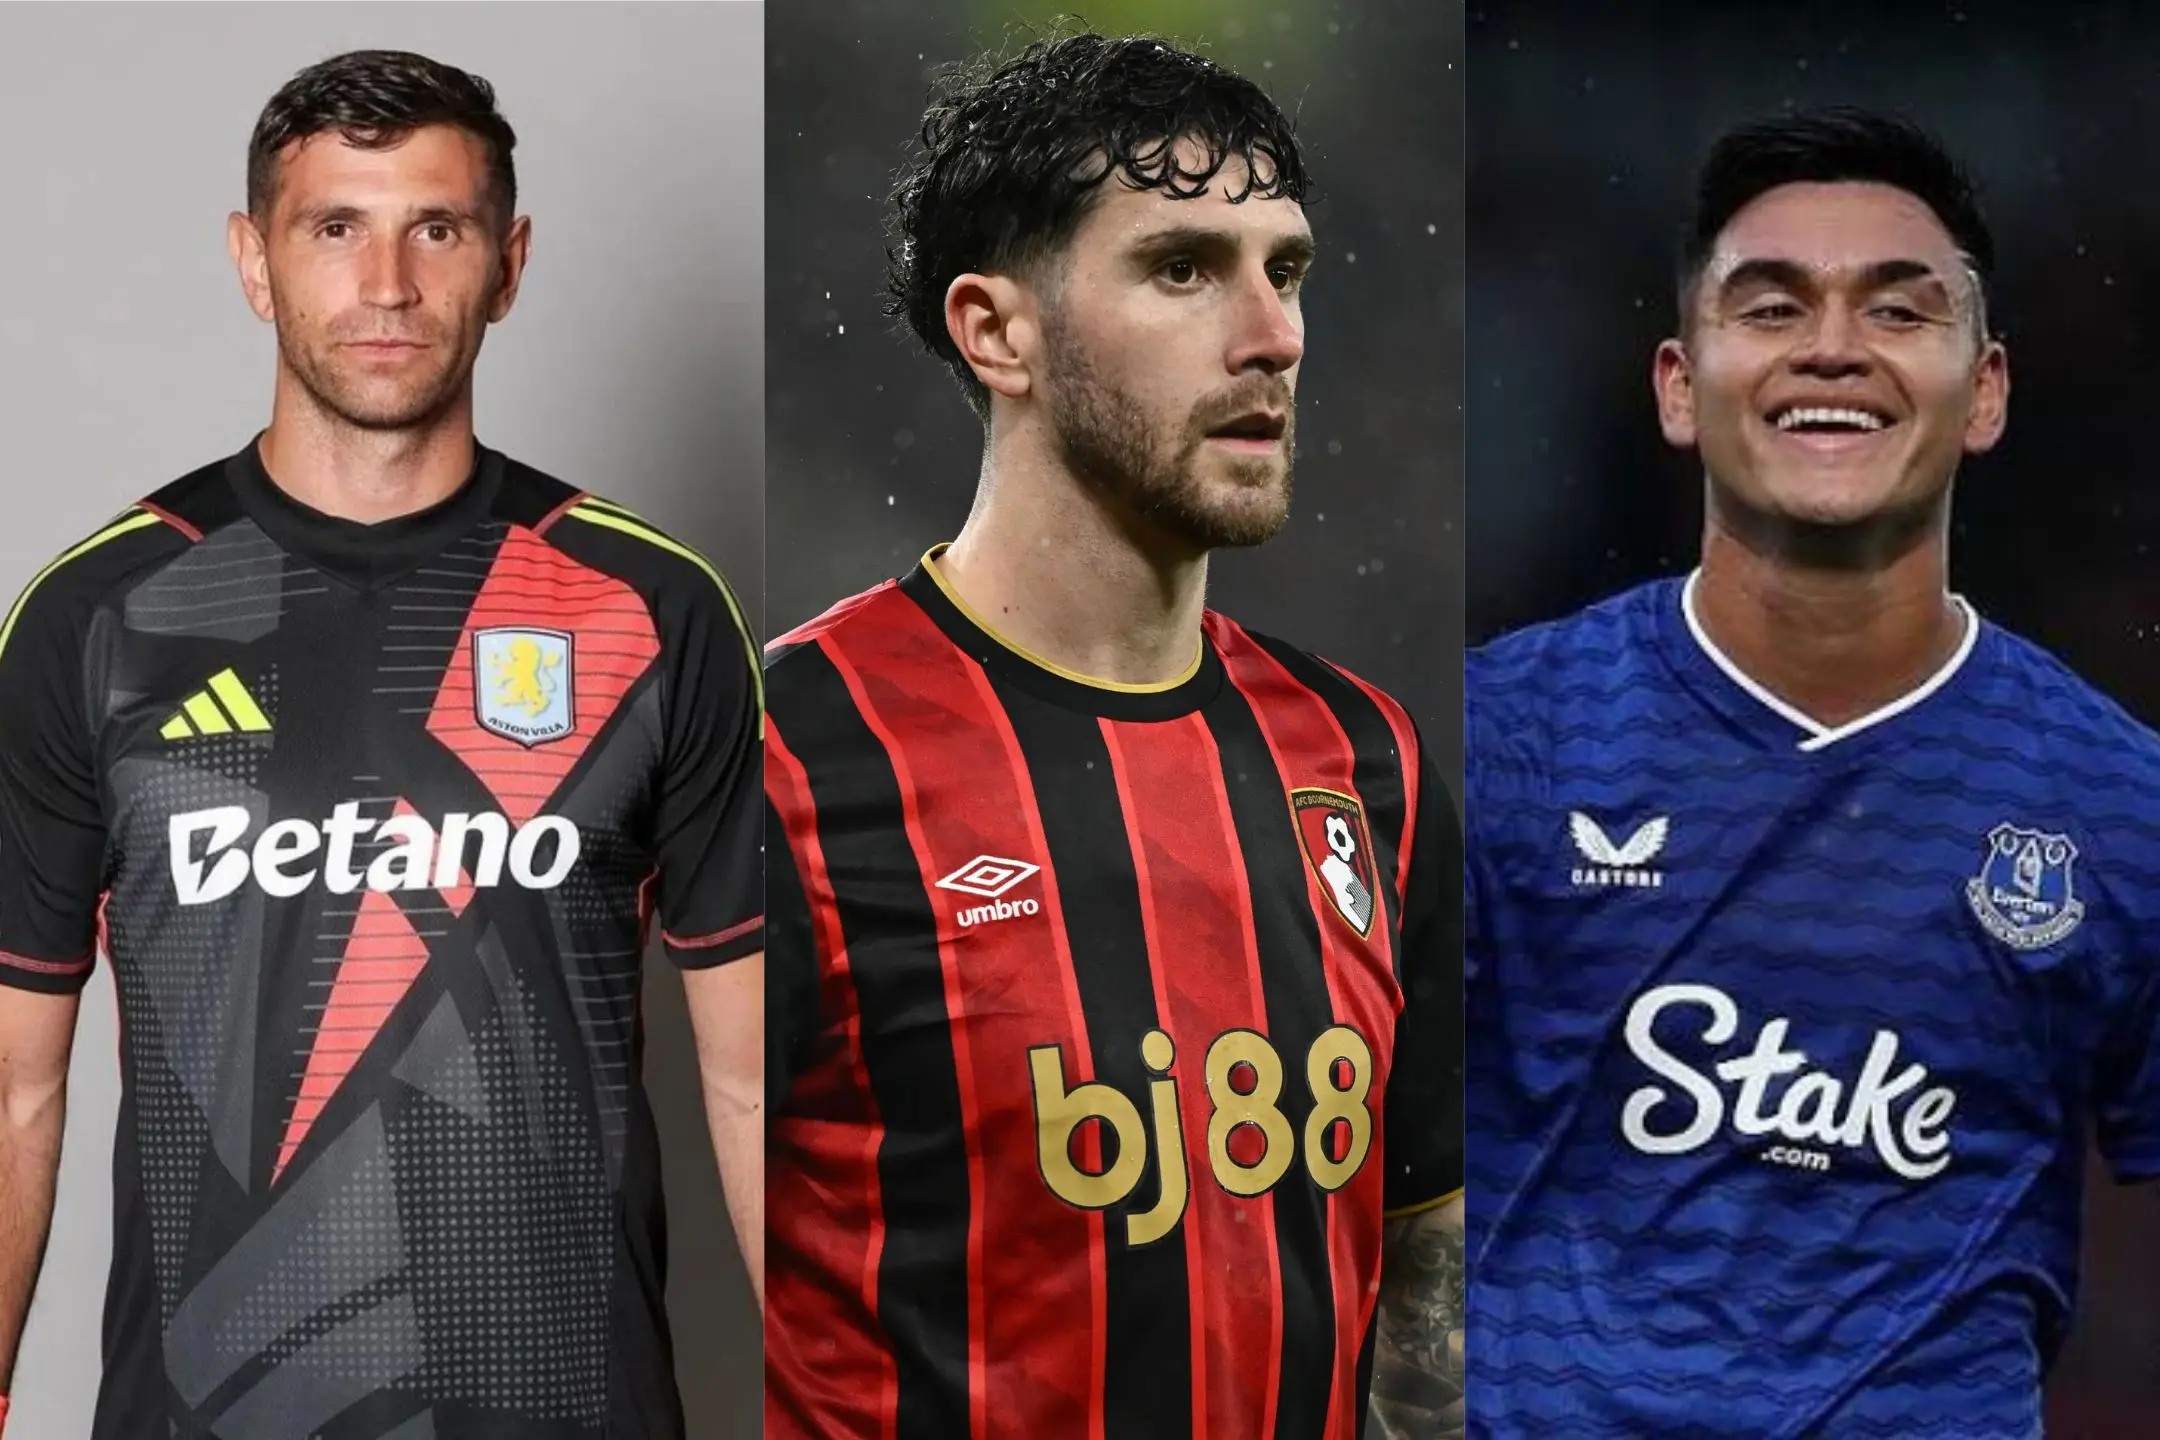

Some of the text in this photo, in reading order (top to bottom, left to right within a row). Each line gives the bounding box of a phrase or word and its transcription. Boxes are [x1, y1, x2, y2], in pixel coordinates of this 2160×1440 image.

[1295, 795, 1359, 815] AFC BOURNEMOUTH
[168, 801, 581, 906] Betano
[956, 898, 1039, 927] umbro
[1621, 983, 1957, 1180] Stake
[1027, 1024, 1374, 1248] bj88
[1760, 1145, 1832, 1171] .com
